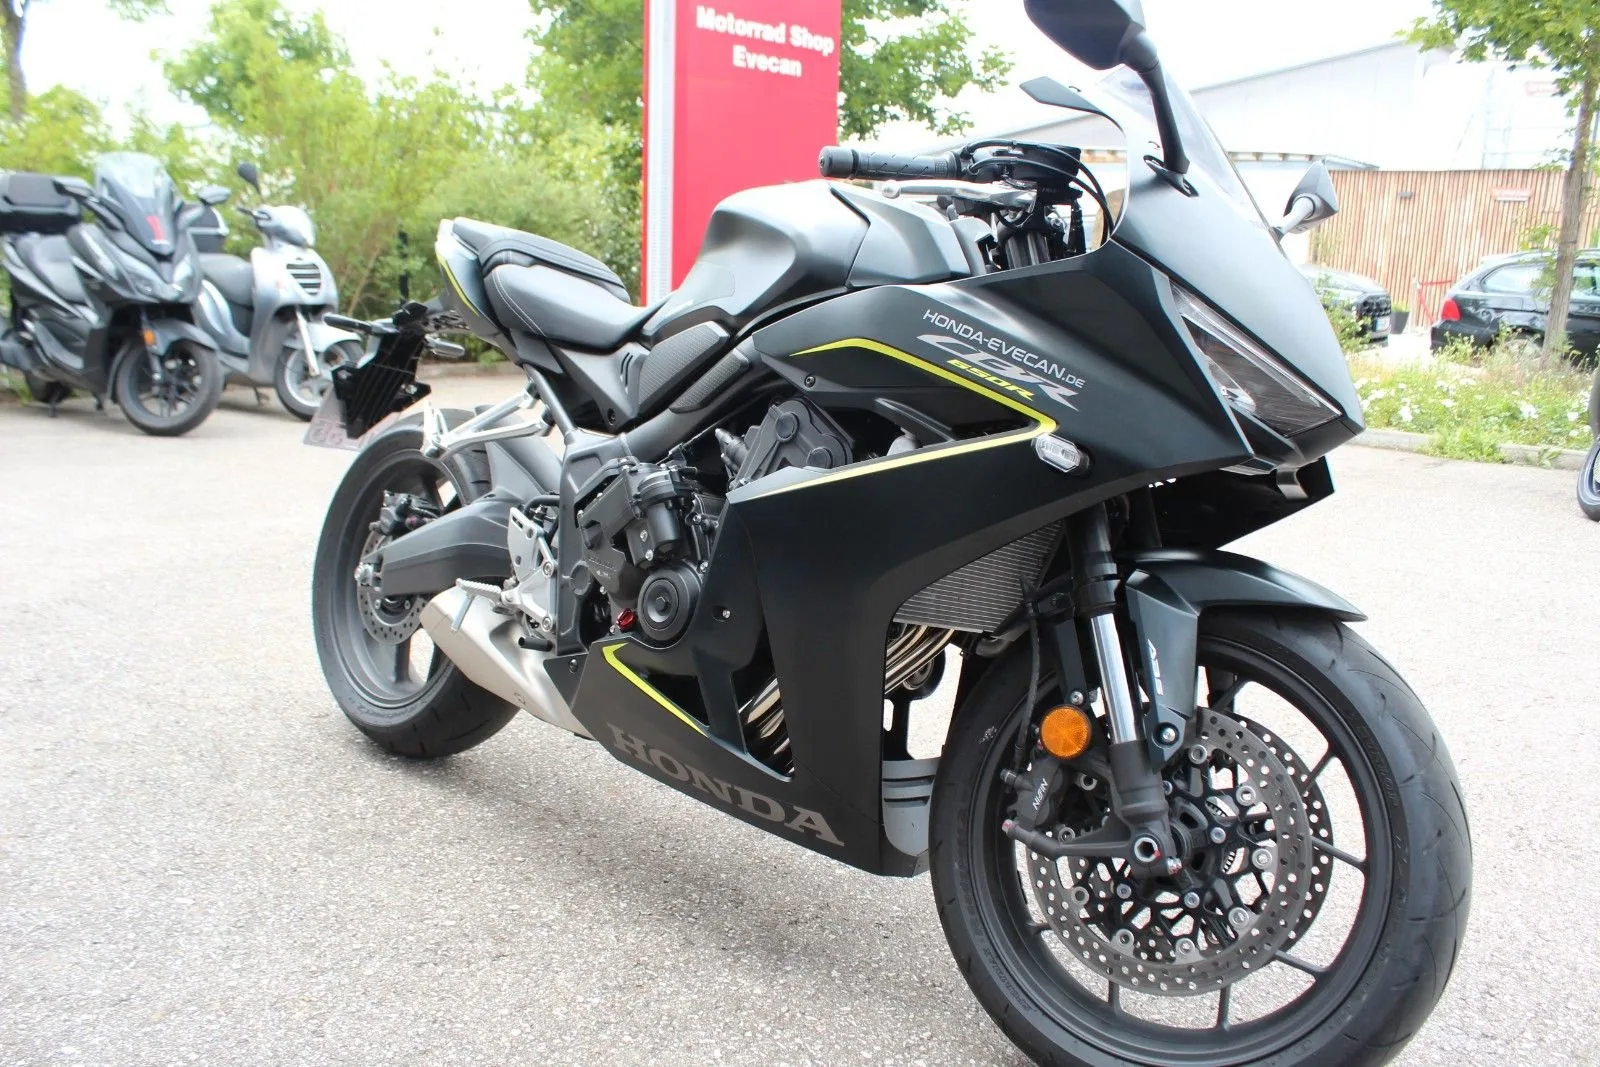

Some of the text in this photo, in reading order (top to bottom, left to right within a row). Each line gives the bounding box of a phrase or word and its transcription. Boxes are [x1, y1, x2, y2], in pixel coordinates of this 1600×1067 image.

[696, 6, 835, 56] Motorrad Shop
[732, 44, 802, 77] Evecan
[916, 333, 1080, 412] CBR
[922, 309, 1086, 389] HONDA-EVECAN.DE
[946, 358, 1035, 402] 650R
[607, 722, 845, 847] HONDA
